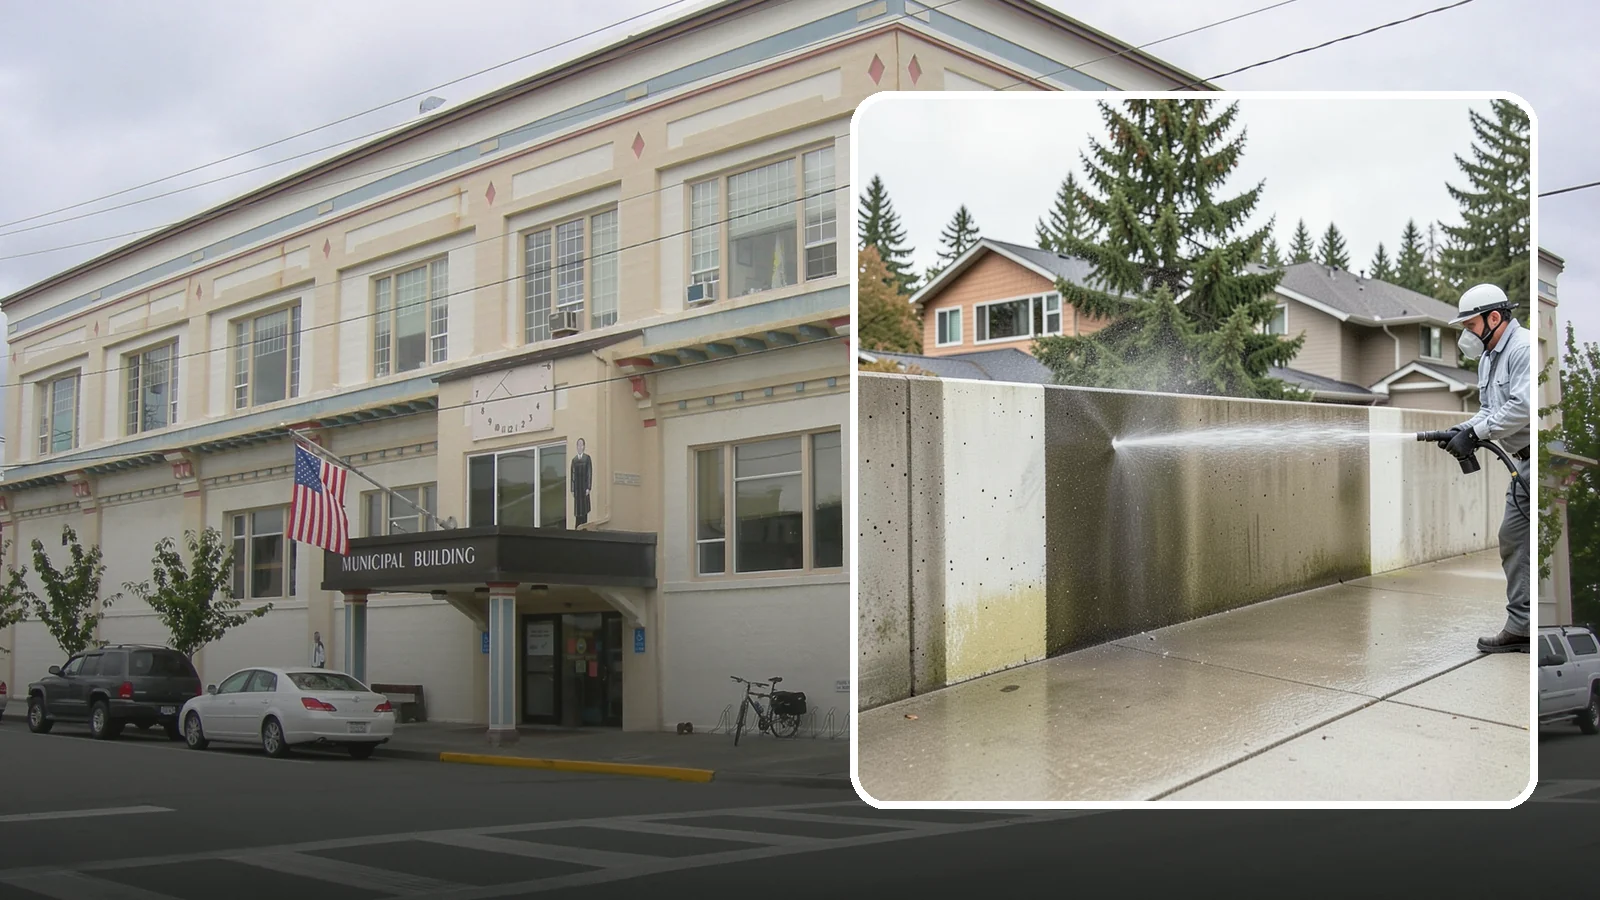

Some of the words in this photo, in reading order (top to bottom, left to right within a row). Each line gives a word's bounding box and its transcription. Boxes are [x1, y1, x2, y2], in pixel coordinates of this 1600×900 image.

[488, 418, 492, 426] 9
[529, 414, 532, 422] 3
[521, 420, 525, 428] 2
[342, 552, 406, 572] MUNICIPAL
[414, 546, 475, 566] BUILDING
